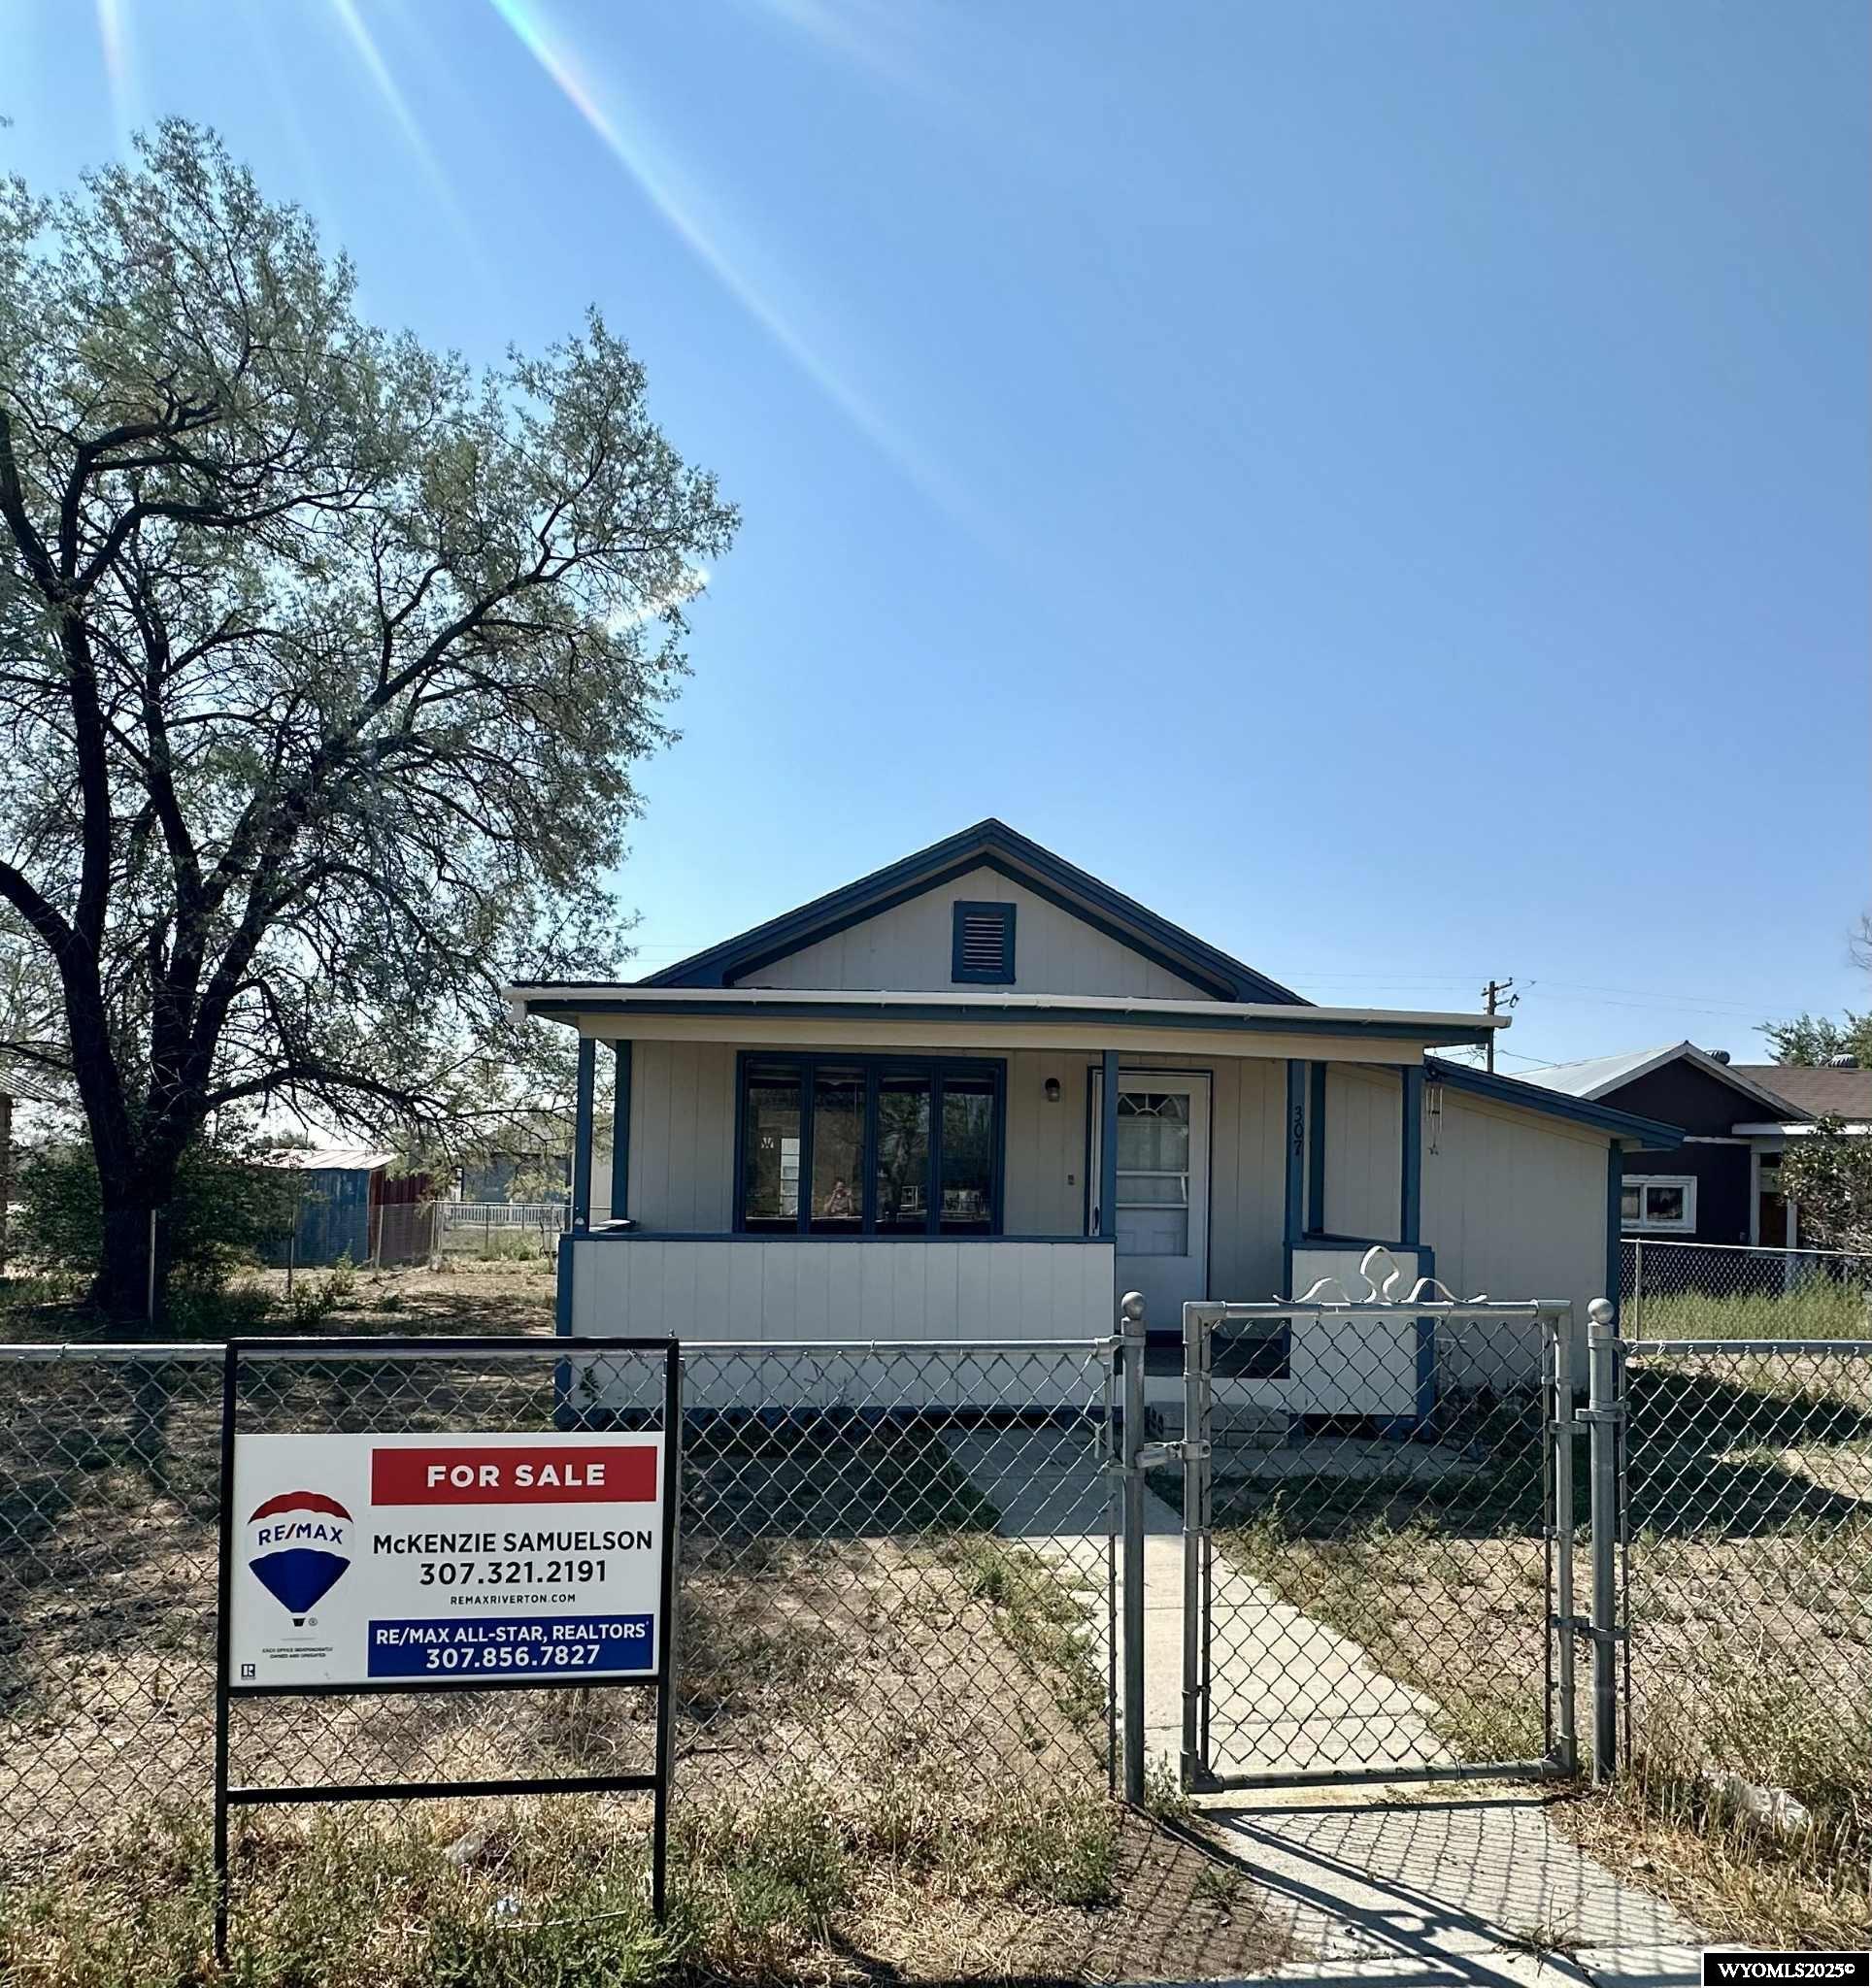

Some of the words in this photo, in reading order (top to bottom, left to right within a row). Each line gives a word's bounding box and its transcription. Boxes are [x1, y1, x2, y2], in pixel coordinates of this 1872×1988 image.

[1293, 1105, 1304, 1156] 307
[427, 1464, 500, 1488] FOR
[515, 1463, 606, 1487] SALE
[258, 1523, 343, 1545] RE/MAX
[373, 1533, 496, 1554] McKENZIE
[503, 1531, 652, 1553] SAMUELSON
[419, 1560, 606, 1585] 307.321.2191
[451, 1593, 576, 1606] REMAXRIVERTON.COM
[376, 1627, 451, 1647] RE/MAX
[453, 1625, 548, 1644] ALL-STAR,
[426, 1644, 600, 1669] 307.856.7827
